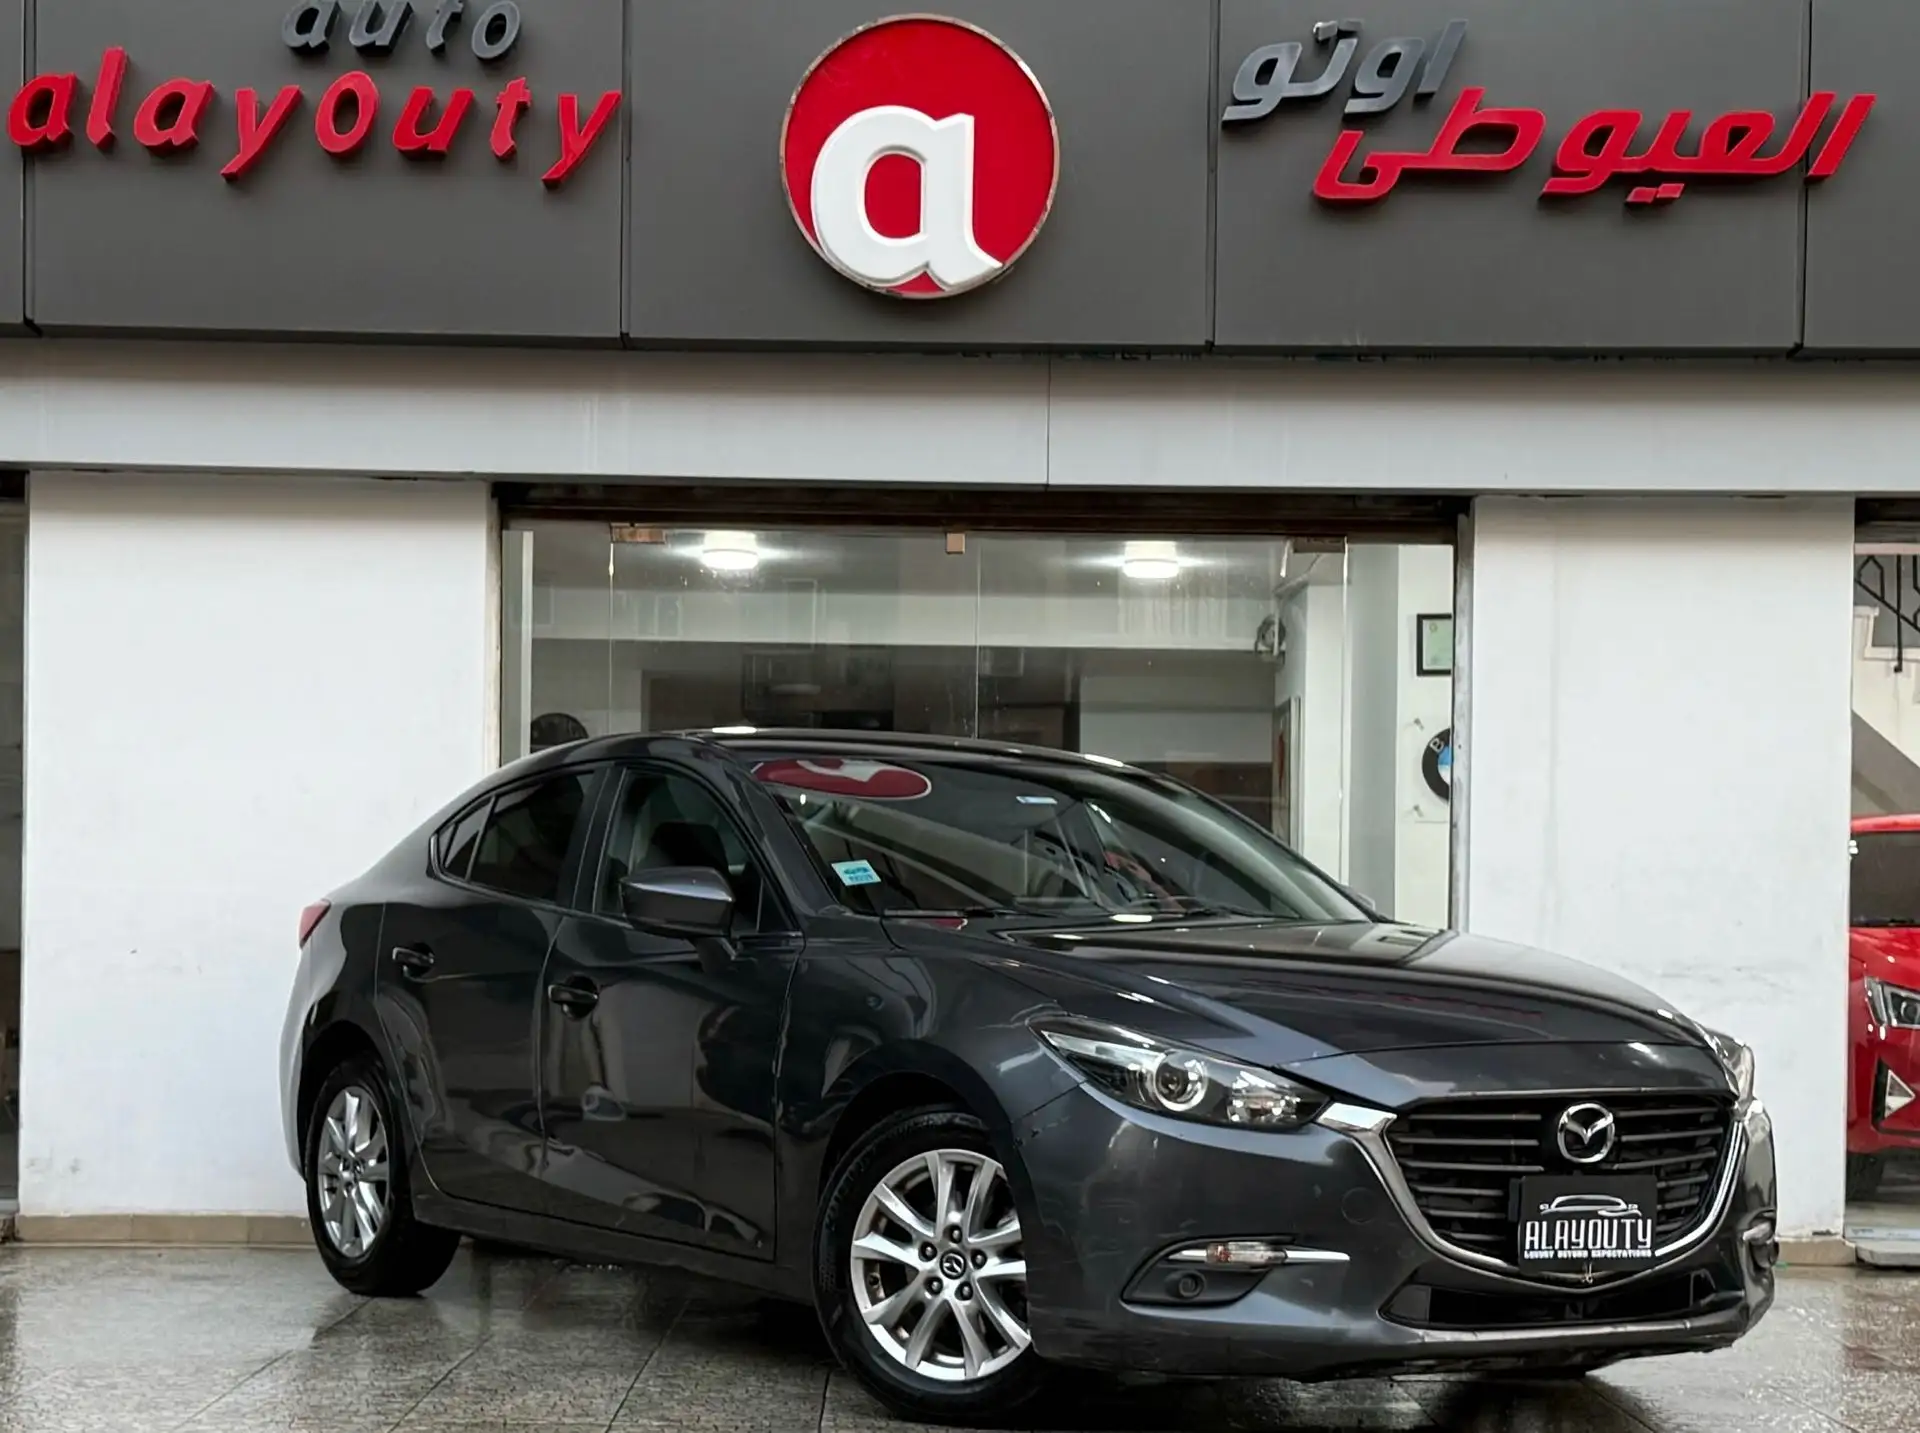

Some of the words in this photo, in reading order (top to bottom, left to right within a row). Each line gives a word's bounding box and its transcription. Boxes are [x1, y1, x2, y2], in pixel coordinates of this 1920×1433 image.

[281, 0, 522, 60] auto
[810, 104, 1003, 292] a
[1525, 1218, 1652, 1250] ALAYOUTY
